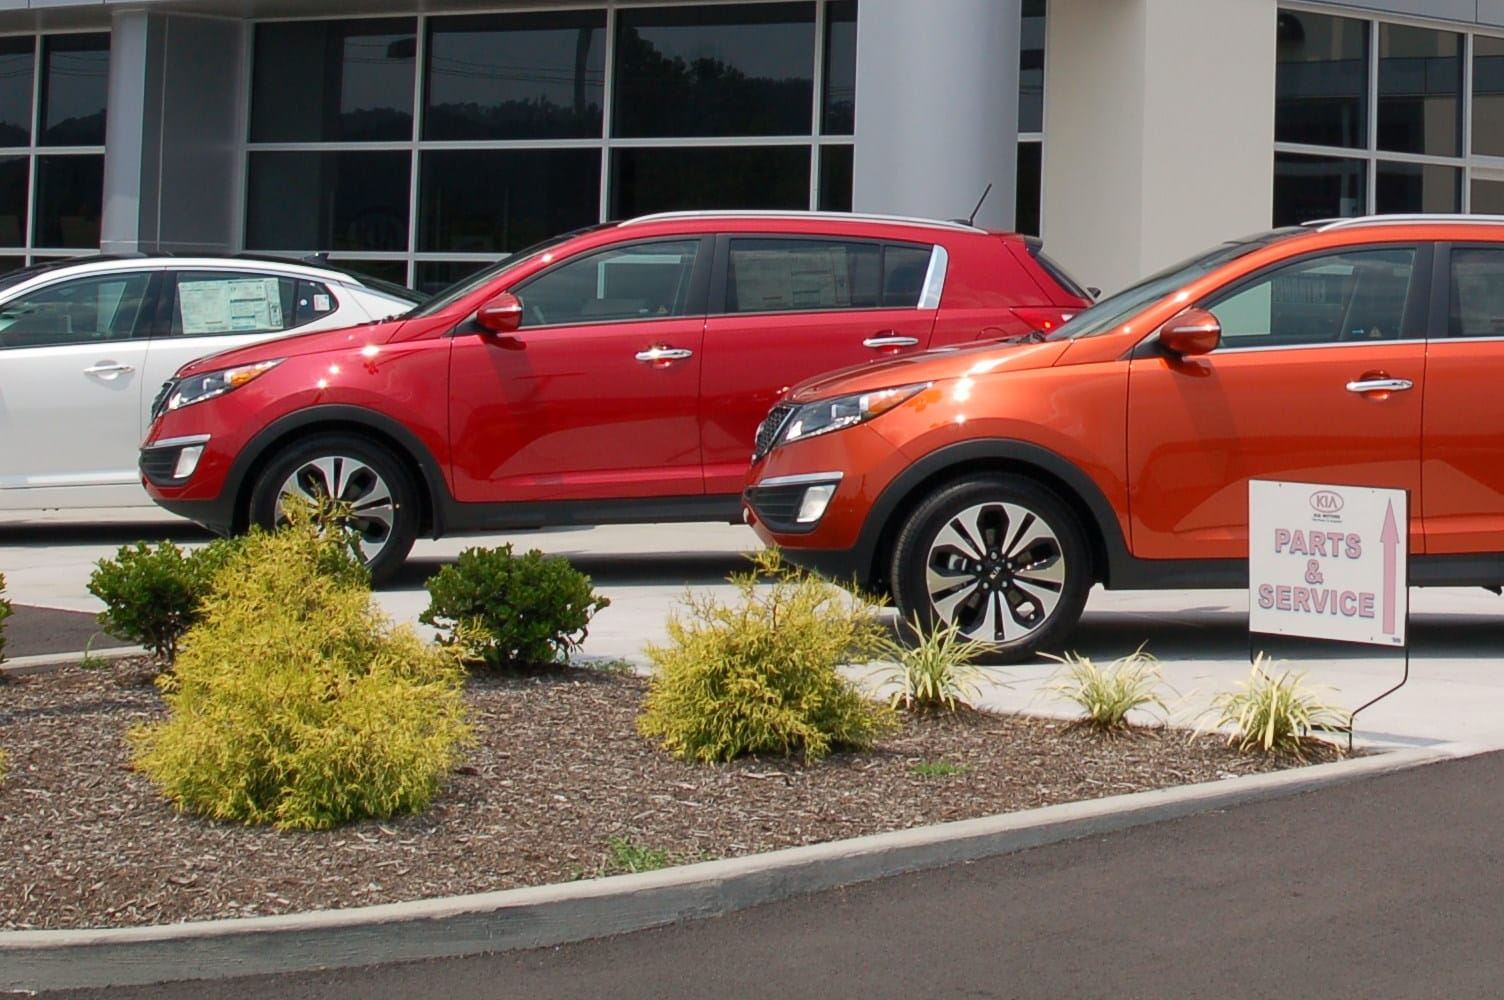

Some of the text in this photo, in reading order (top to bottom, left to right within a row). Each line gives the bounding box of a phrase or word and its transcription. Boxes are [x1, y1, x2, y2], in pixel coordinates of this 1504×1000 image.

[1274, 528, 1362, 559] PARTS
[1304, 559, 1324, 584] &
[1258, 583, 1375, 618] SERVICE
